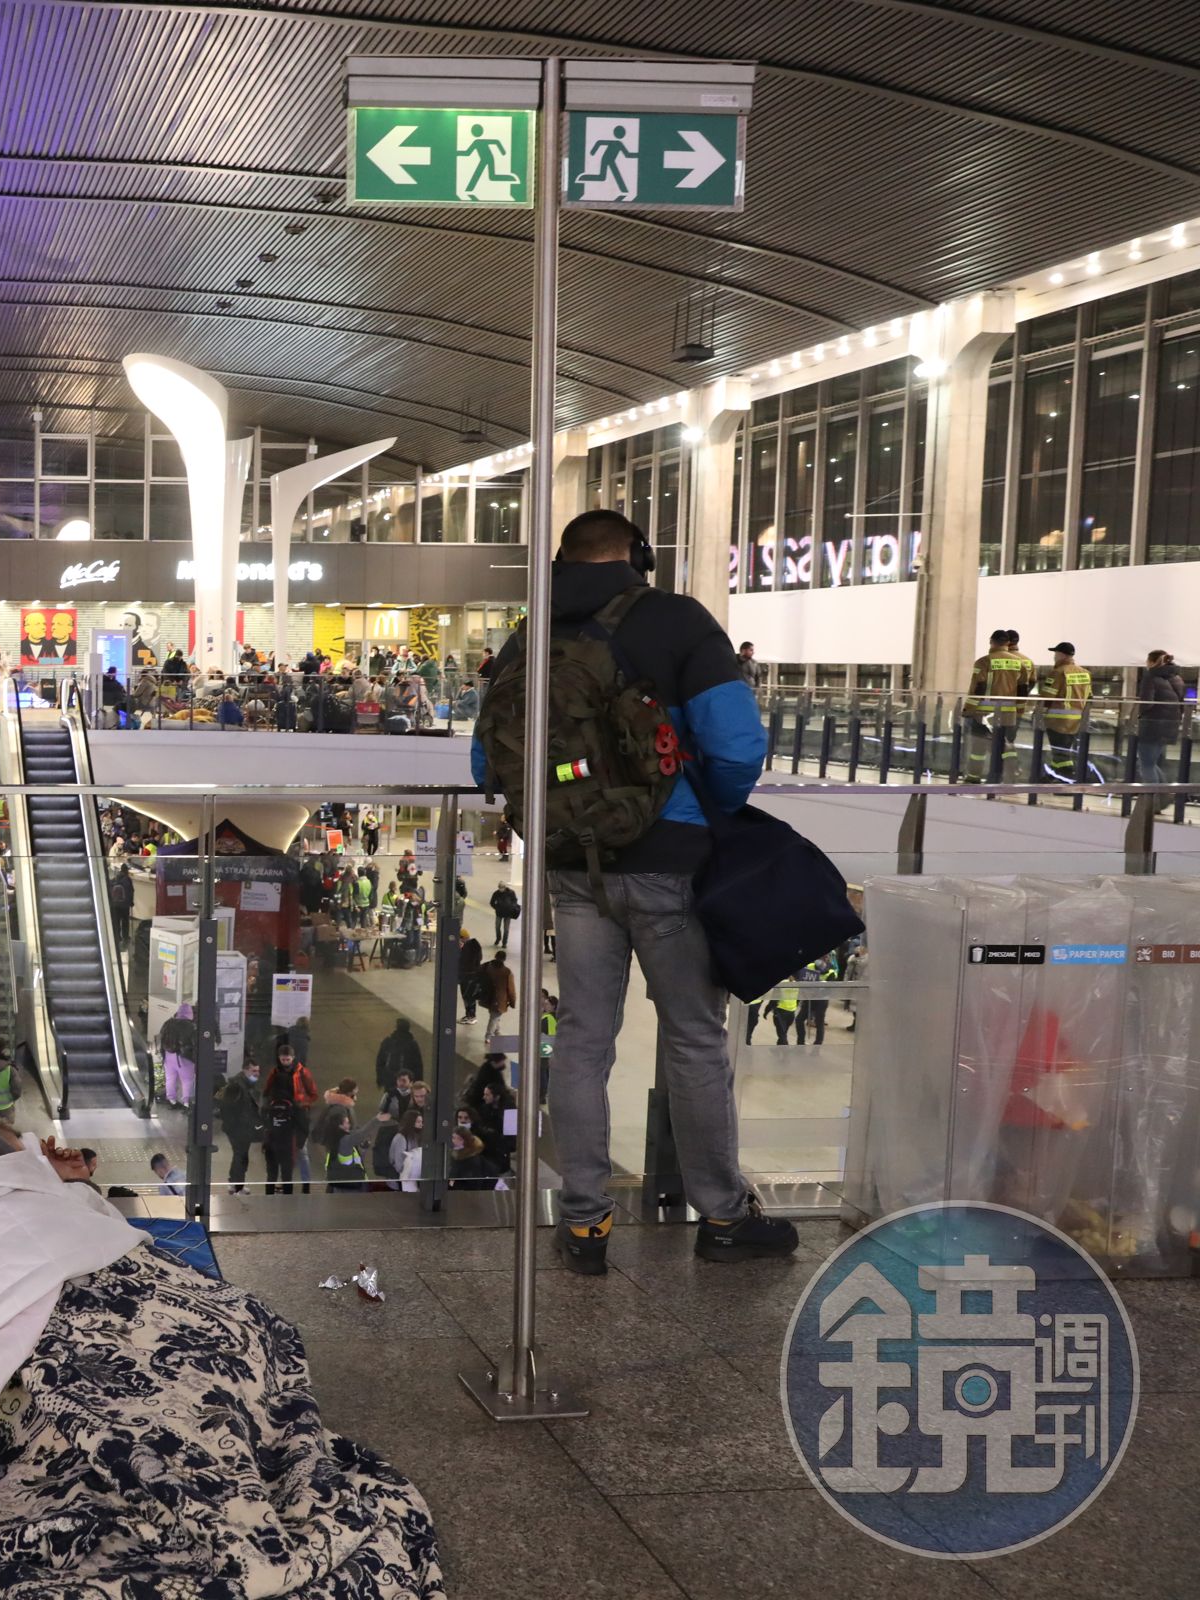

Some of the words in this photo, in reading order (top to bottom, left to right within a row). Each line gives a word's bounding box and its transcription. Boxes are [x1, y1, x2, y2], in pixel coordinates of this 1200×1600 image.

[176, 560, 323, 581] Mond's
[1069, 950, 1098, 959] PAPIER
[1100, 950, 1126, 959] PAPER
[1162, 950, 1175, 958] BIO
